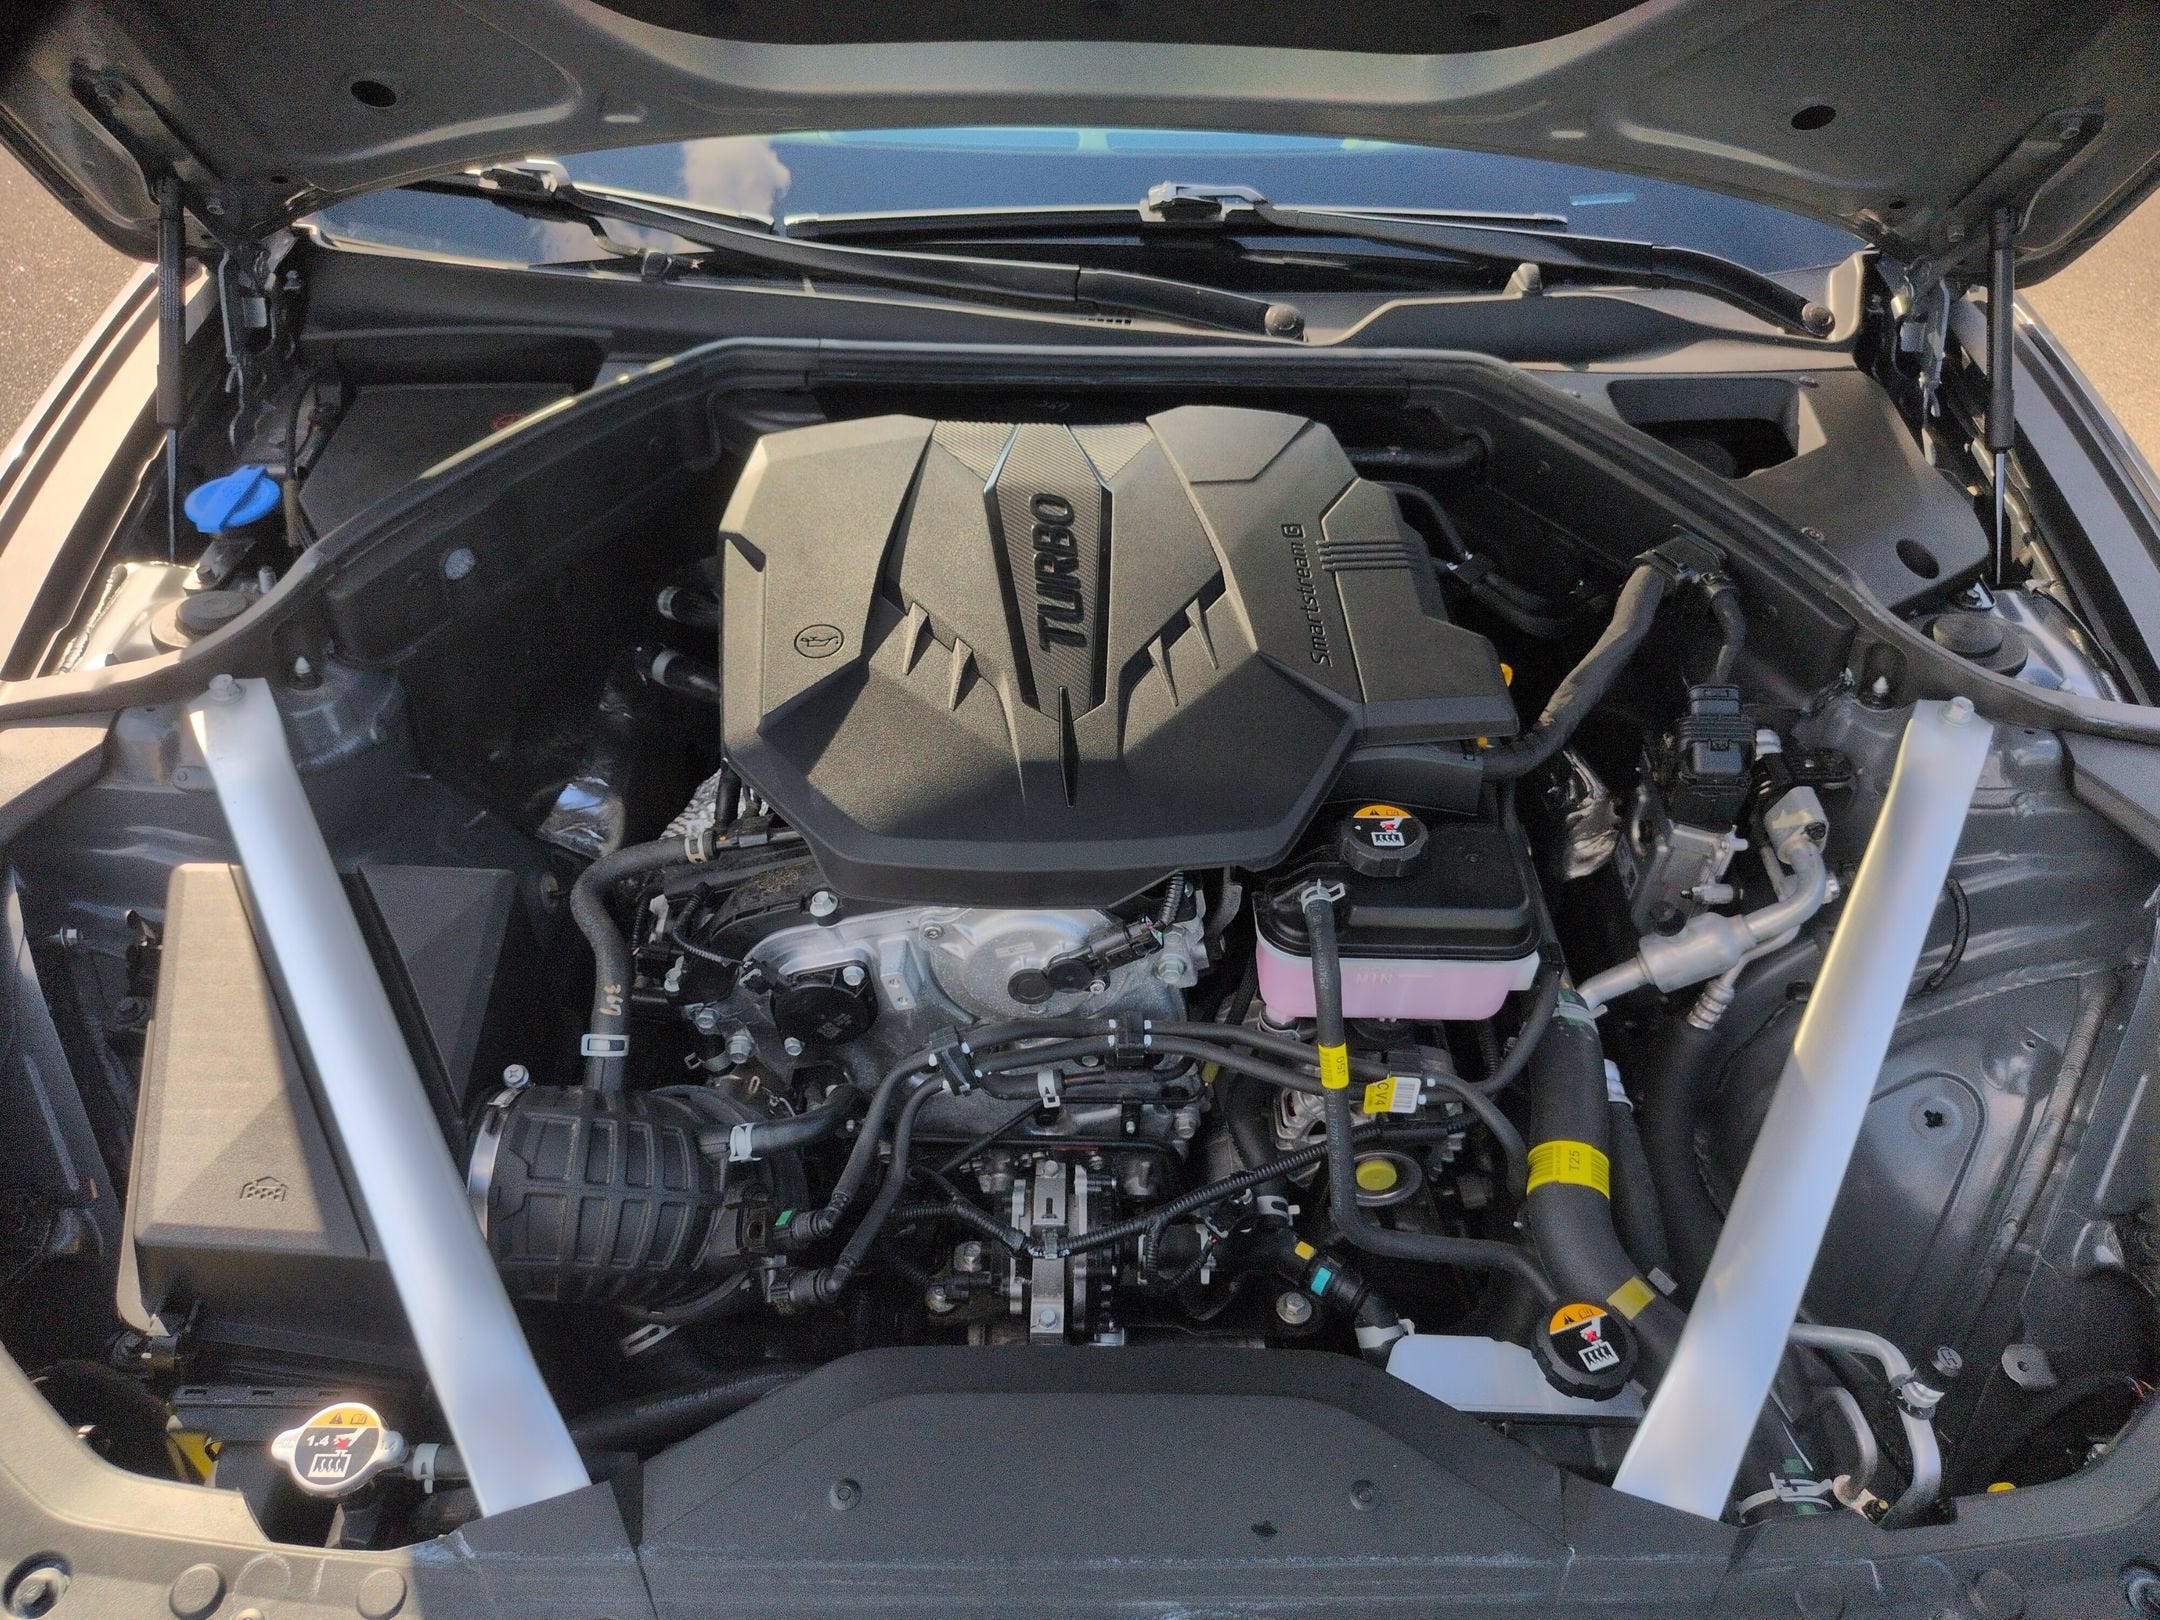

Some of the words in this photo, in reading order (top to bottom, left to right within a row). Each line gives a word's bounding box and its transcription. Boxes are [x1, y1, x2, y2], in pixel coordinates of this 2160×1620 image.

[1281, 523, 1304, 538] G
[1029, 493, 1088, 653] TURBO
[1291, 541, 1333, 668] Smartstream
[1355, 972, 1393, 985] MIN
[1335, 1055, 1346, 1076] J50
[1375, 1082, 1390, 1106] CV4
[1568, 1149, 1580, 1172] T25
[306, 1434, 330, 1448] 1.4
